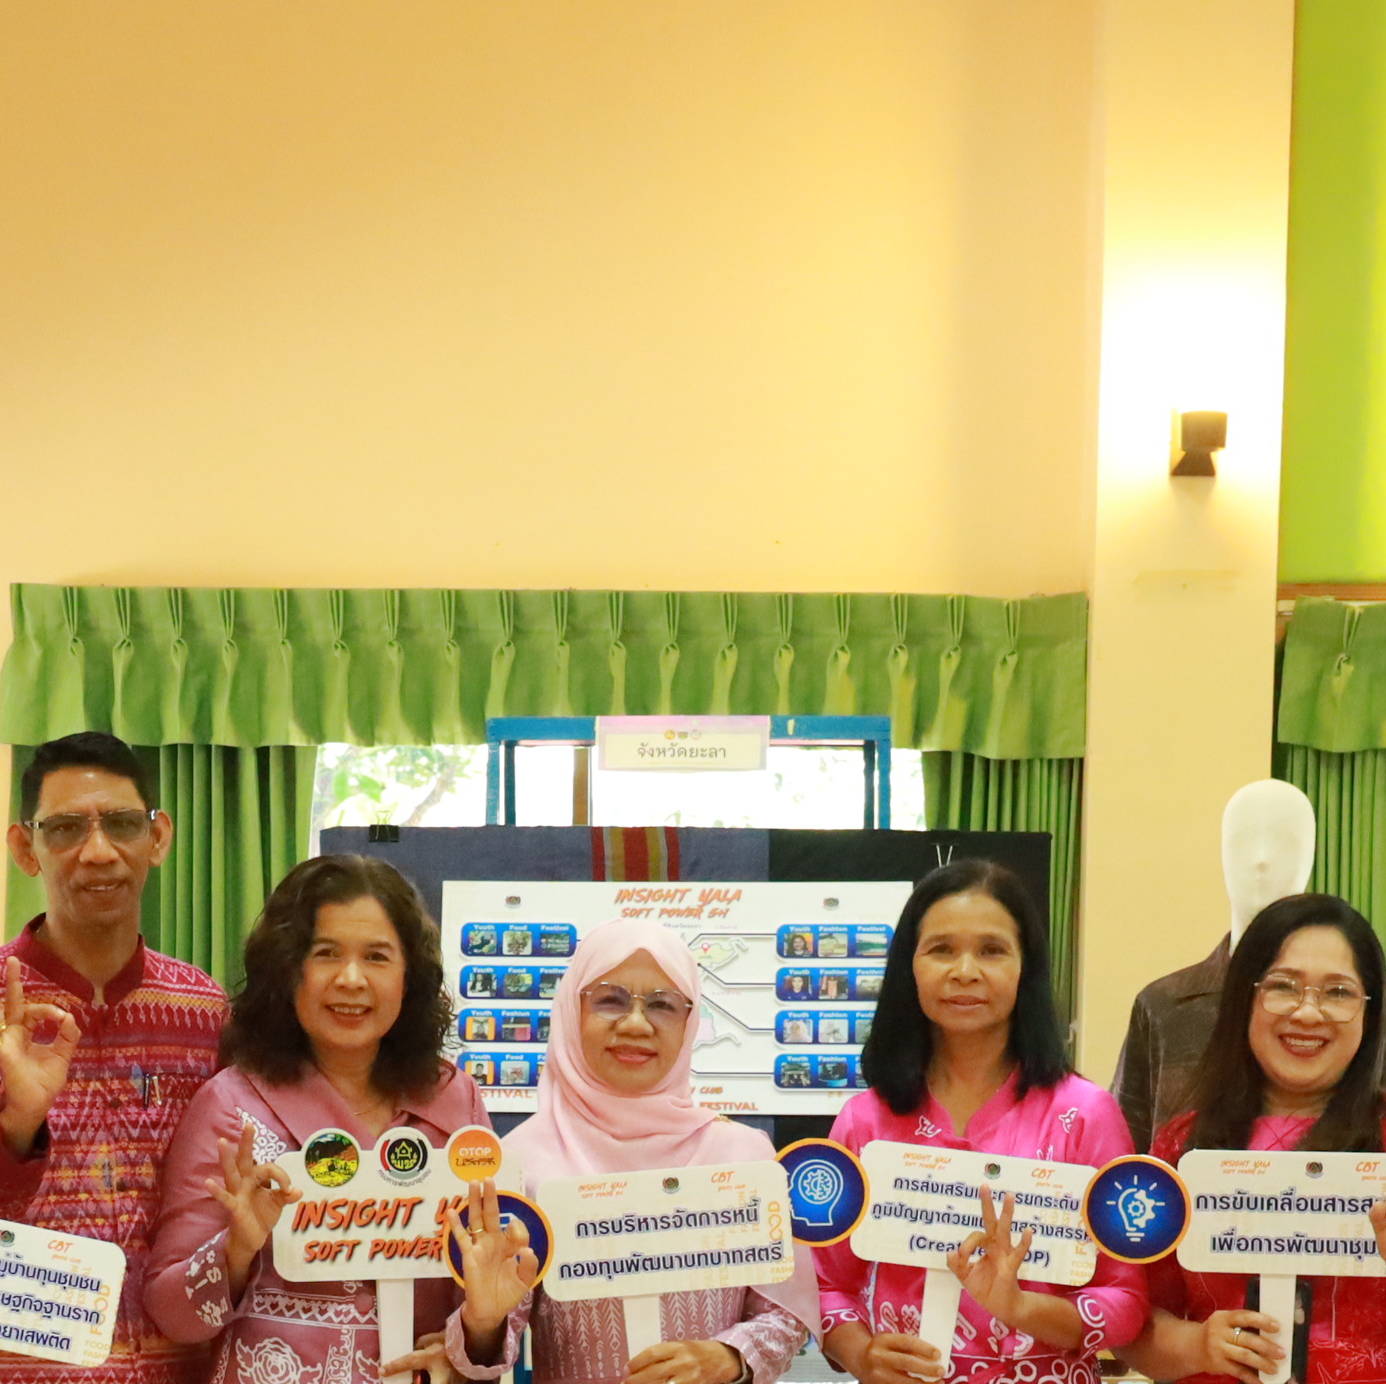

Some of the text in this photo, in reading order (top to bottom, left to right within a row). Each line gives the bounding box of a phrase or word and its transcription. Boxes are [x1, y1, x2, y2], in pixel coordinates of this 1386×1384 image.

[636, 742, 727, 759] จังหวัดยะลา
[614, 887, 743, 908] INSIGHT YALA
[620, 907, 655, 919] SOFT
[658, 905, 704, 920] POWER
[480, 1088, 533, 1099] STIVAL
[458, 1146, 493, 1157] OTOP
[1355, 1161, 1380, 1172] CBT
[710, 1170, 735, 1183] CBT
[291, 1195, 424, 1234] INSIGHT
[576, 1196, 762, 1238] การบริหารจัดการหนี้
[47, 1239, 74, 1253] CBT
[304, 1234, 443, 1264] SOFT POWER
[558, 1240, 783, 1281] กองทุนพัฒนาบทบาทสตรี
